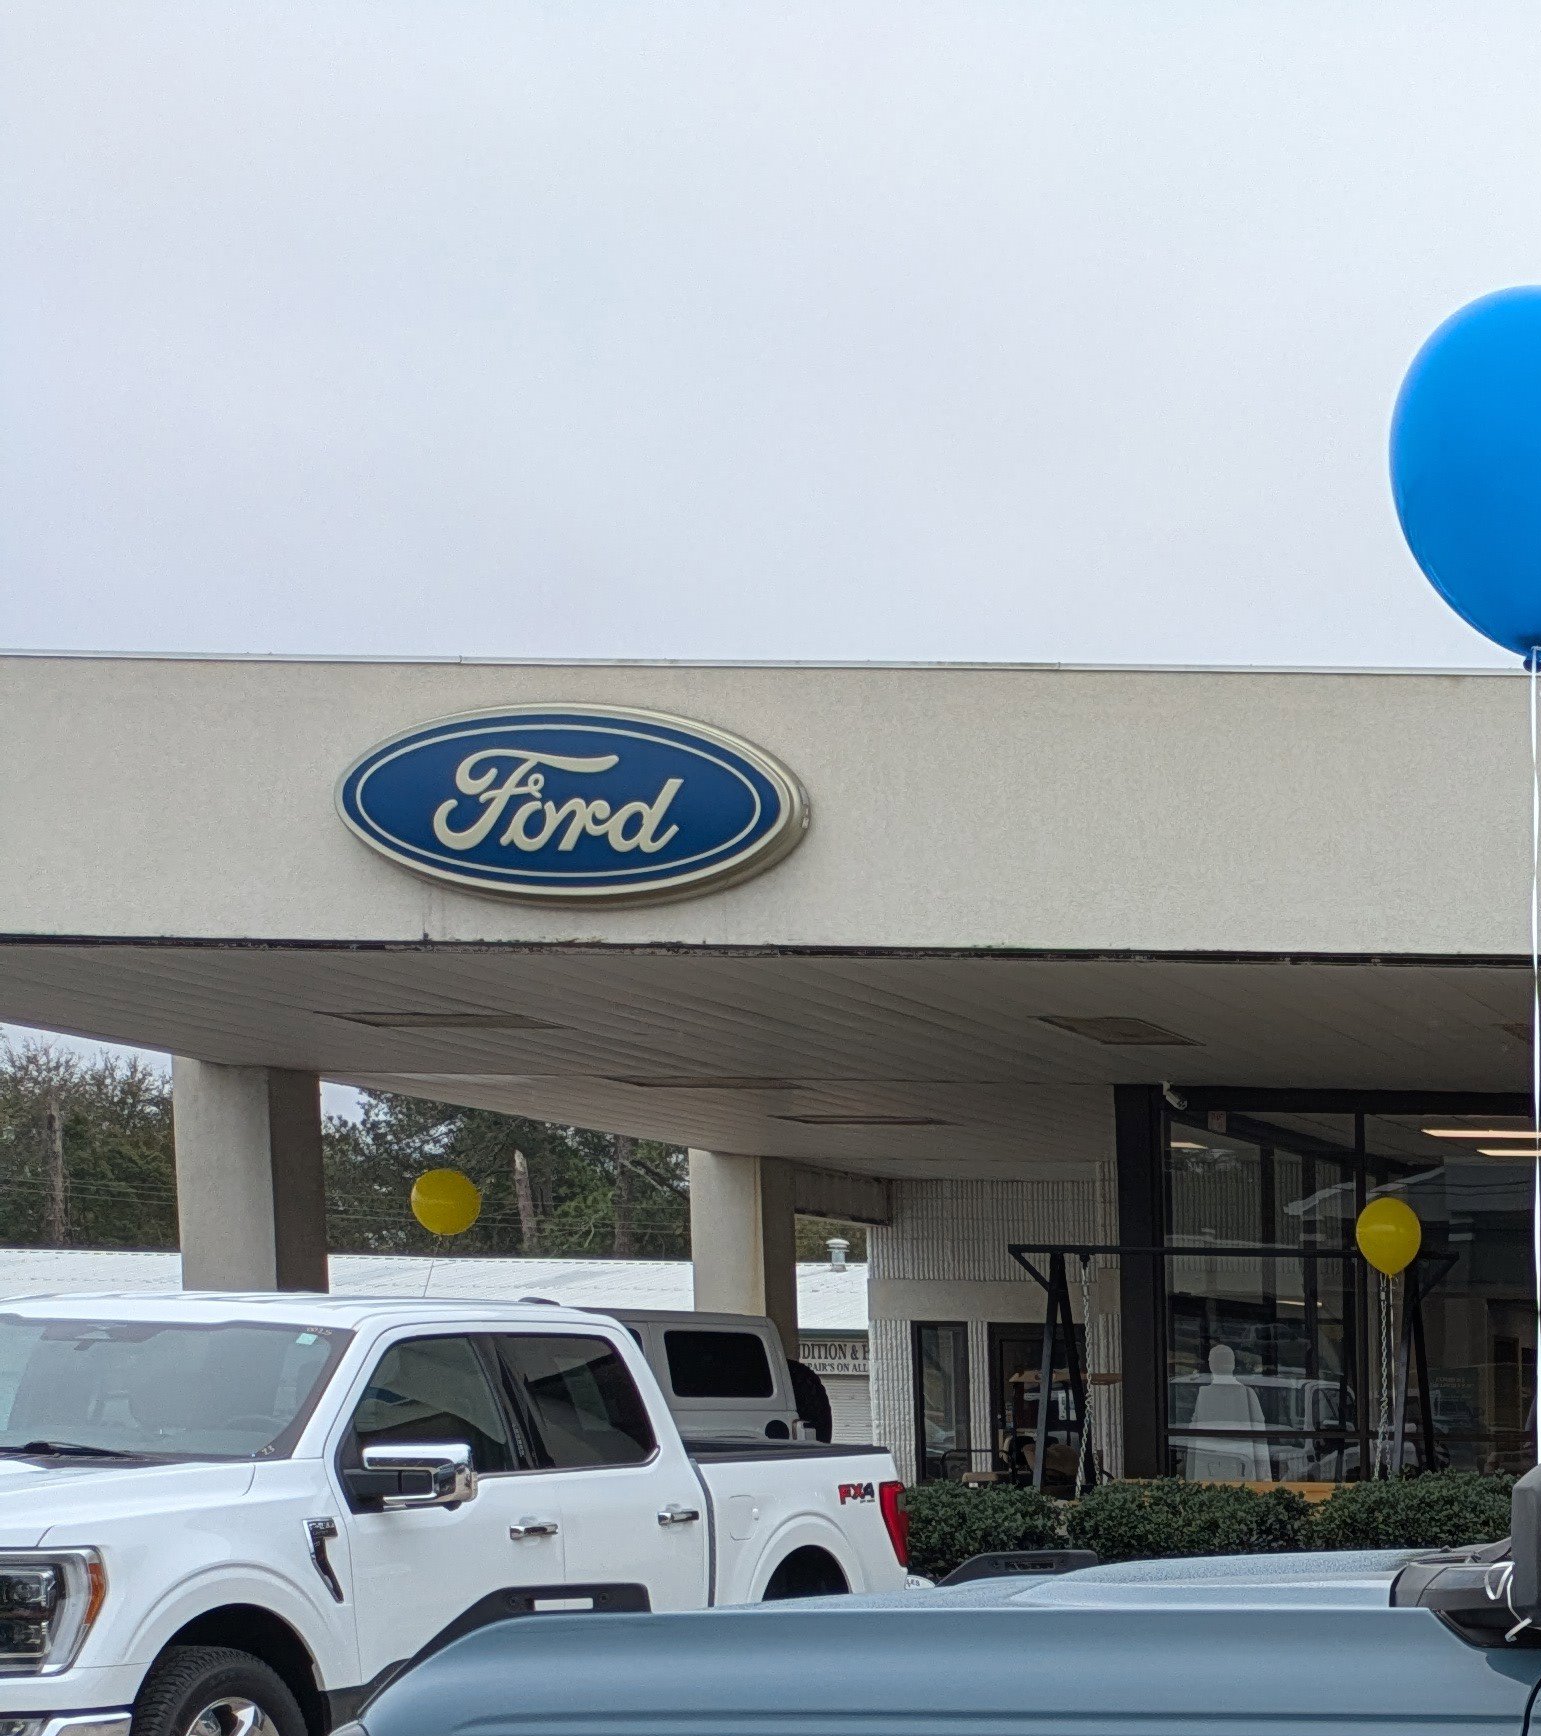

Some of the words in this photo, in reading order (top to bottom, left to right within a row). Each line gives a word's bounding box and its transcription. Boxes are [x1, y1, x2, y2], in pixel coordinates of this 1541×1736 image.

[433, 748, 684, 853] Ford
[850, 1344, 859, 1360] &
[804, 1362, 835, 1373] PAIR'S
[836, 1363, 850, 1373] ON
[838, 1482, 875, 1505] FX4
